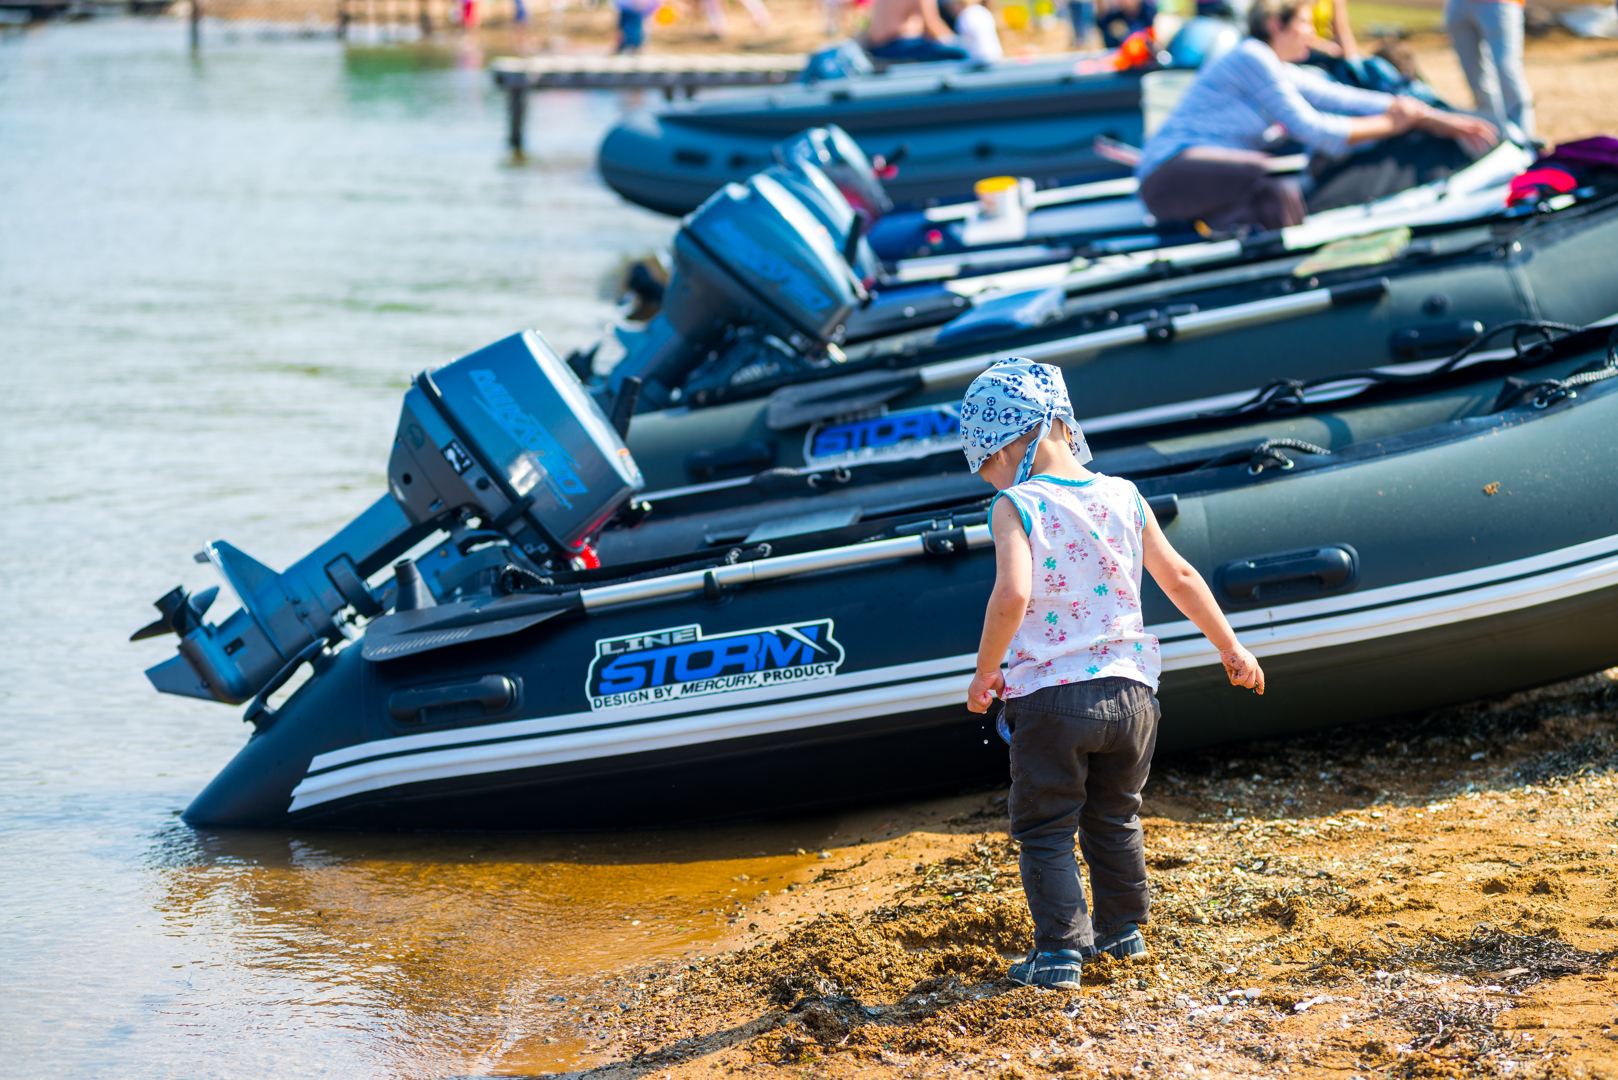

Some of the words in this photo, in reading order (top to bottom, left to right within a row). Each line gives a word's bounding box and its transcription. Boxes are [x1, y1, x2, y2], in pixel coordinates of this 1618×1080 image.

[599, 625, 820, 695] STORM
[602, 627, 696, 656] LINE
[593, 690, 649, 709] DESIGN
[653, 685, 673, 699] BY
[762, 663, 835, 683] PRODUCT
